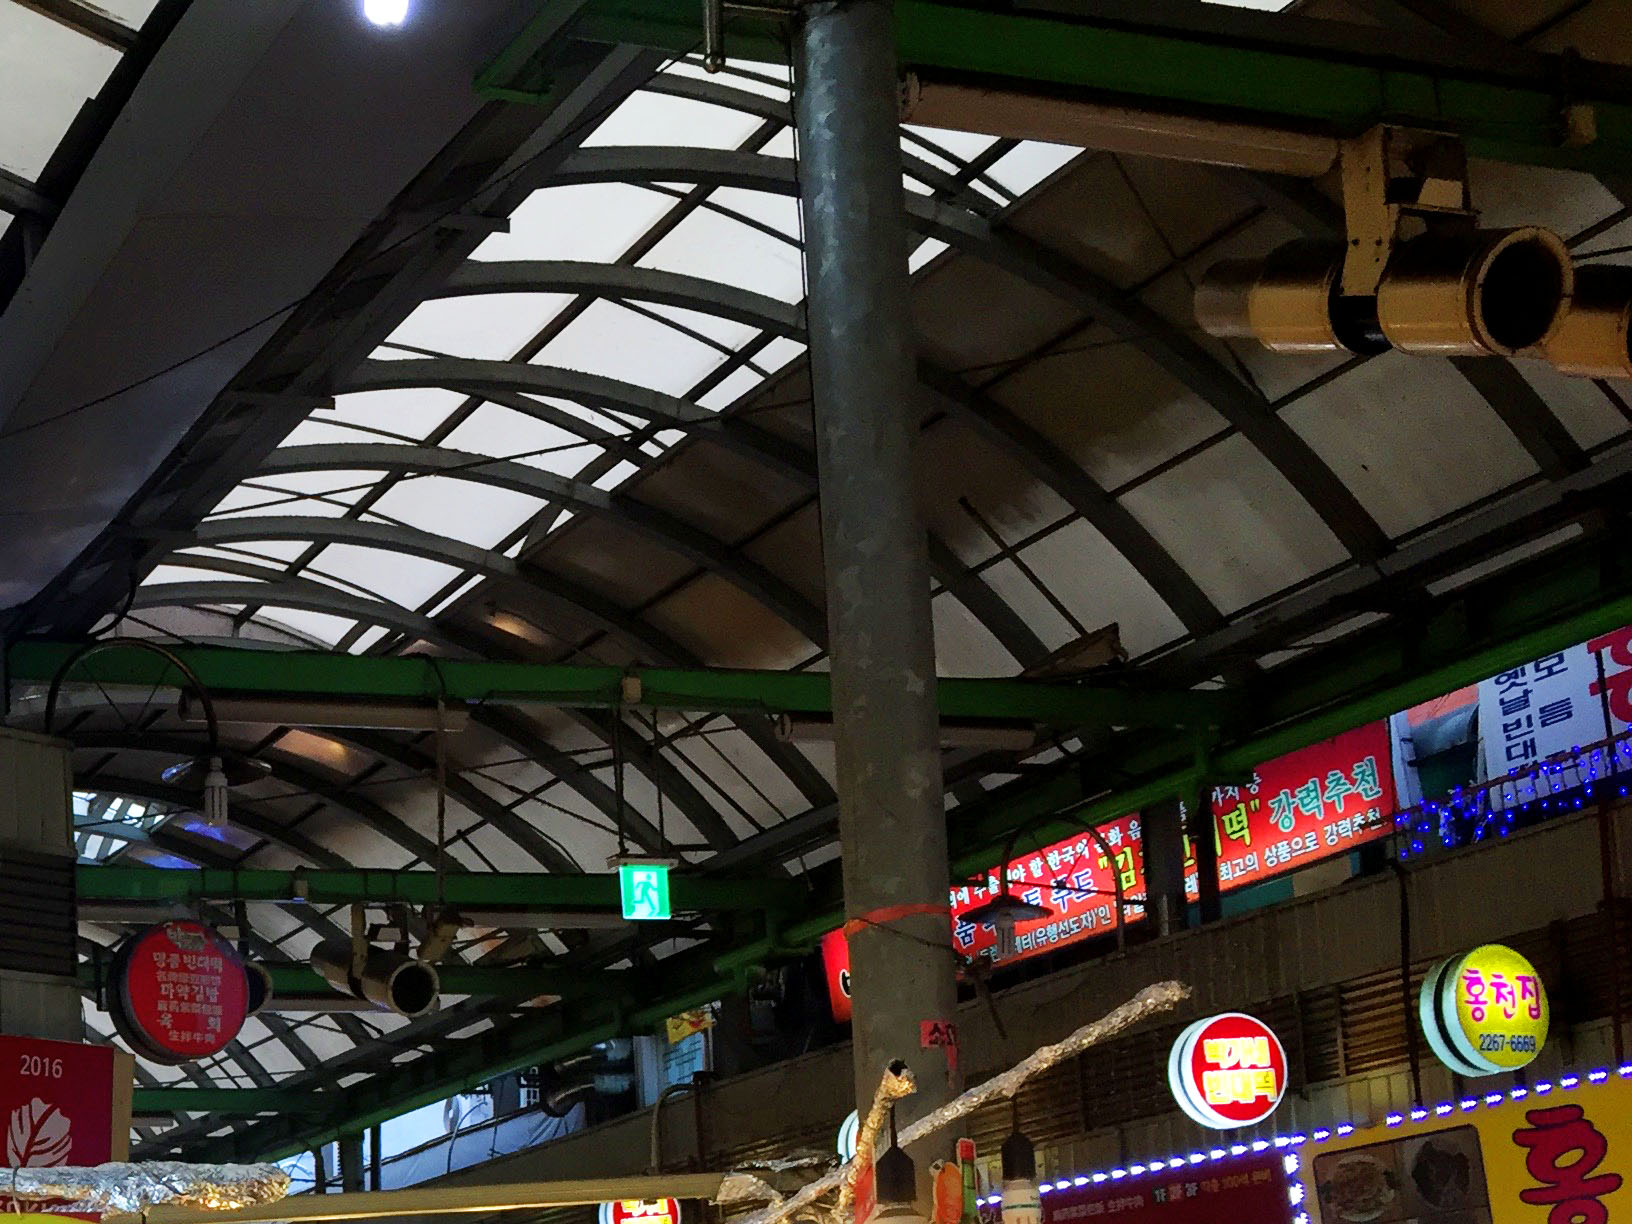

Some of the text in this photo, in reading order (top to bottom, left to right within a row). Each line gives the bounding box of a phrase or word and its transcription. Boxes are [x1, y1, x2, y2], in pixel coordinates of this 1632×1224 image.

[1269, 755, 1383, 832] 강력추천
[1263, 831, 1320, 868] 상품으로
[1463, 967, 1542, 1023] 홍천집
[19, 1054, 64, 1079] 2016
